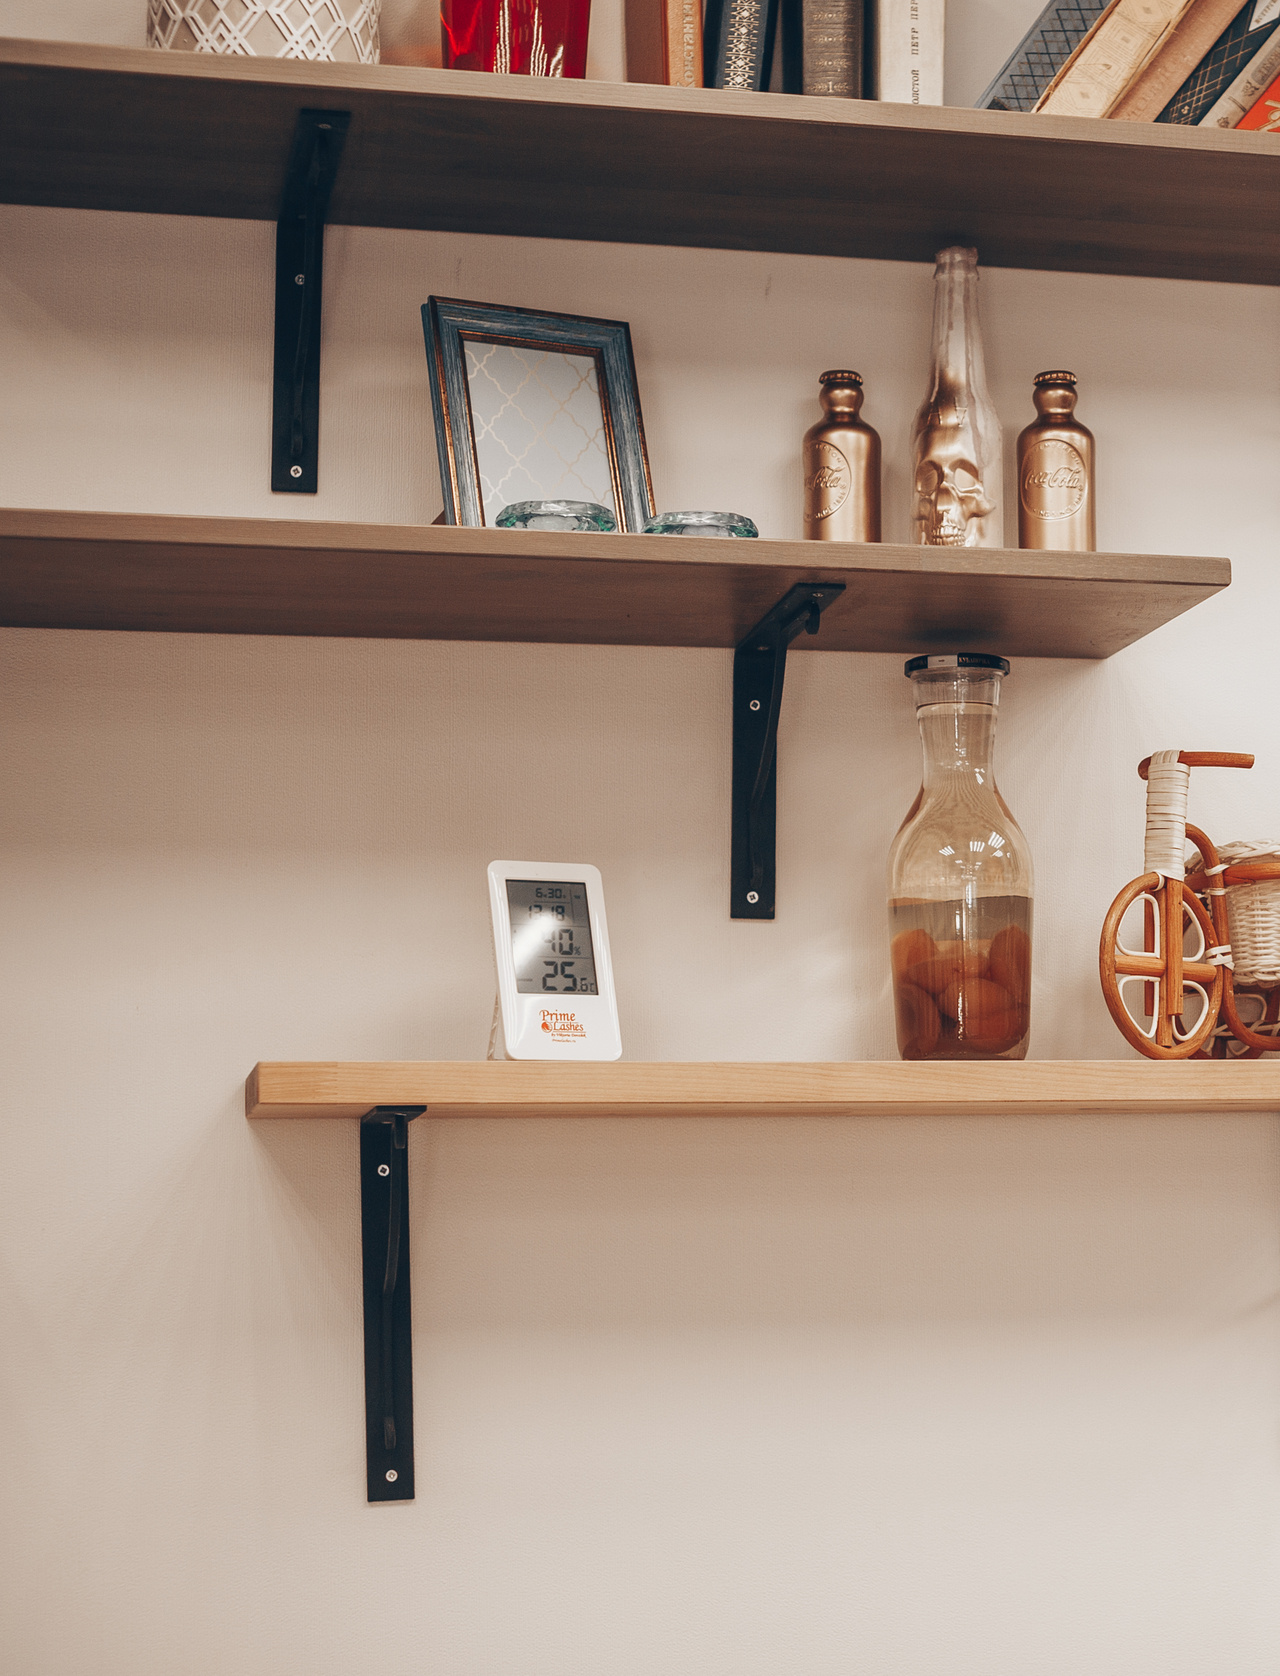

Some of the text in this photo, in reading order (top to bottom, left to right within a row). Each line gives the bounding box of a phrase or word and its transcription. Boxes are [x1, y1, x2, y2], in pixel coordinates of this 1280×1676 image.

[911, 27, 919, 55] ПЕТР
[539, 1009, 576, 1021] Prime
[553, 1020, 584, 1031] Lashes
